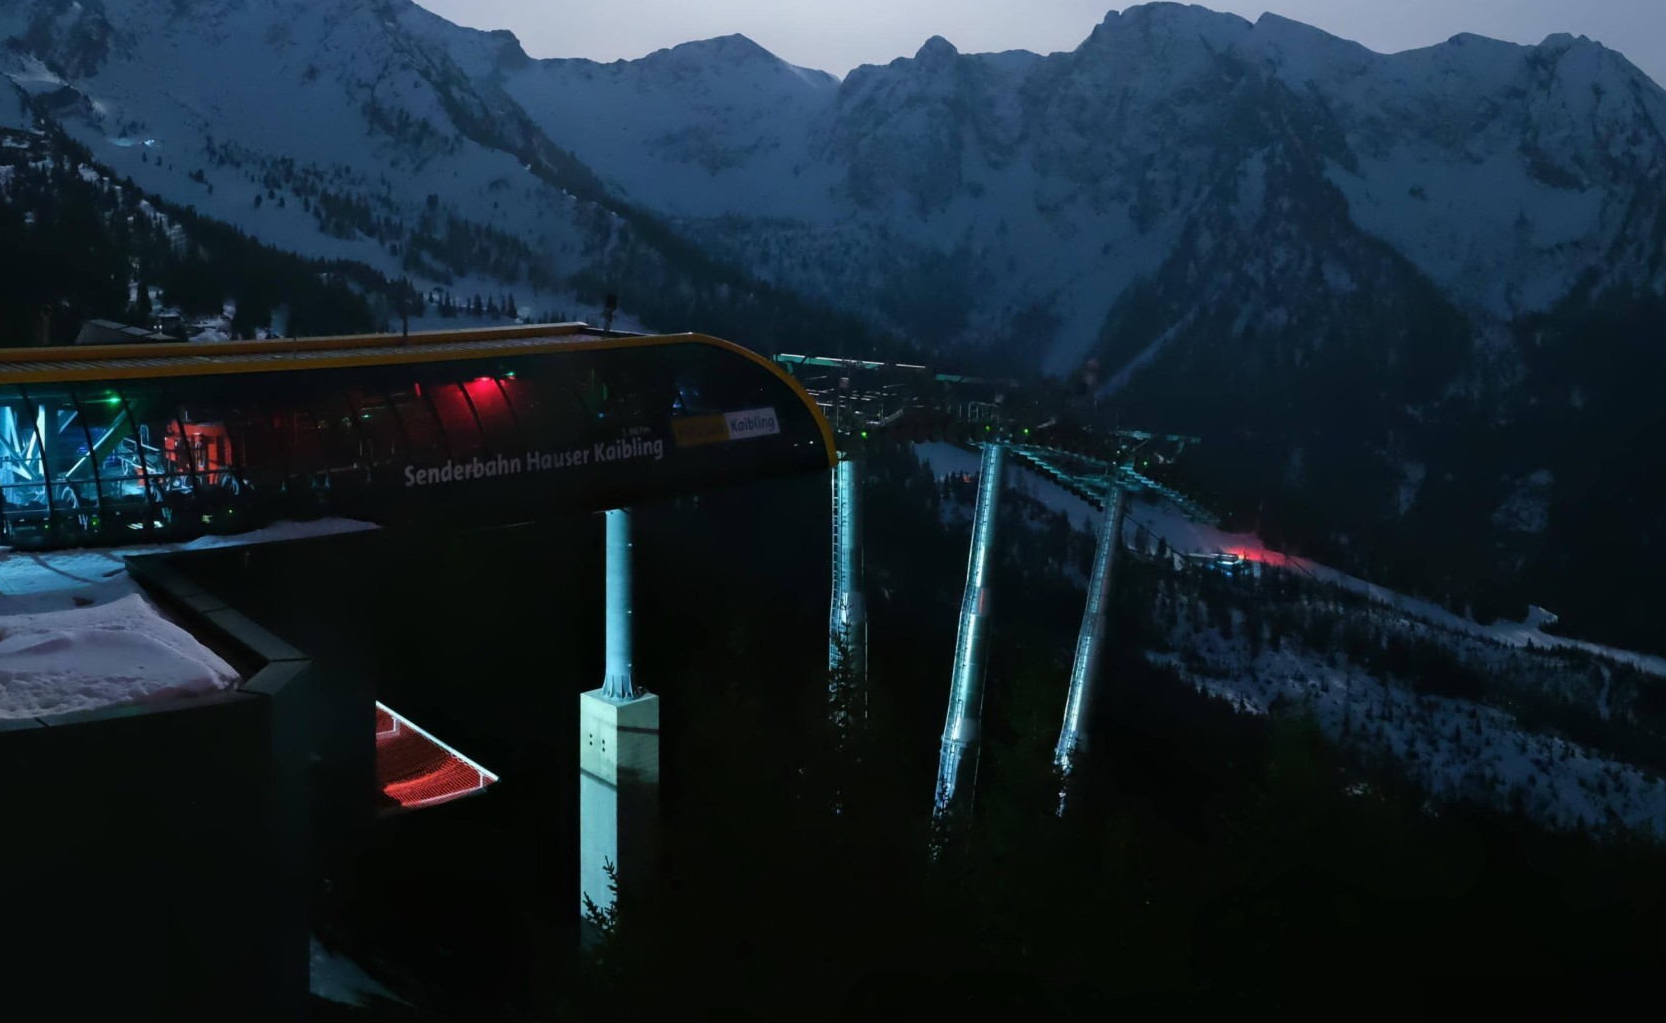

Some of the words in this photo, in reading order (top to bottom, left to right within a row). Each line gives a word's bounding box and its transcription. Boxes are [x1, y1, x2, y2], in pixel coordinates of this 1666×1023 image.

[730, 416, 775, 432] Kaibling
[404, 454, 521, 487] Senderbahn
[526, 447, 590, 473] Hauser
[594, 437, 664, 463] Kaibling
